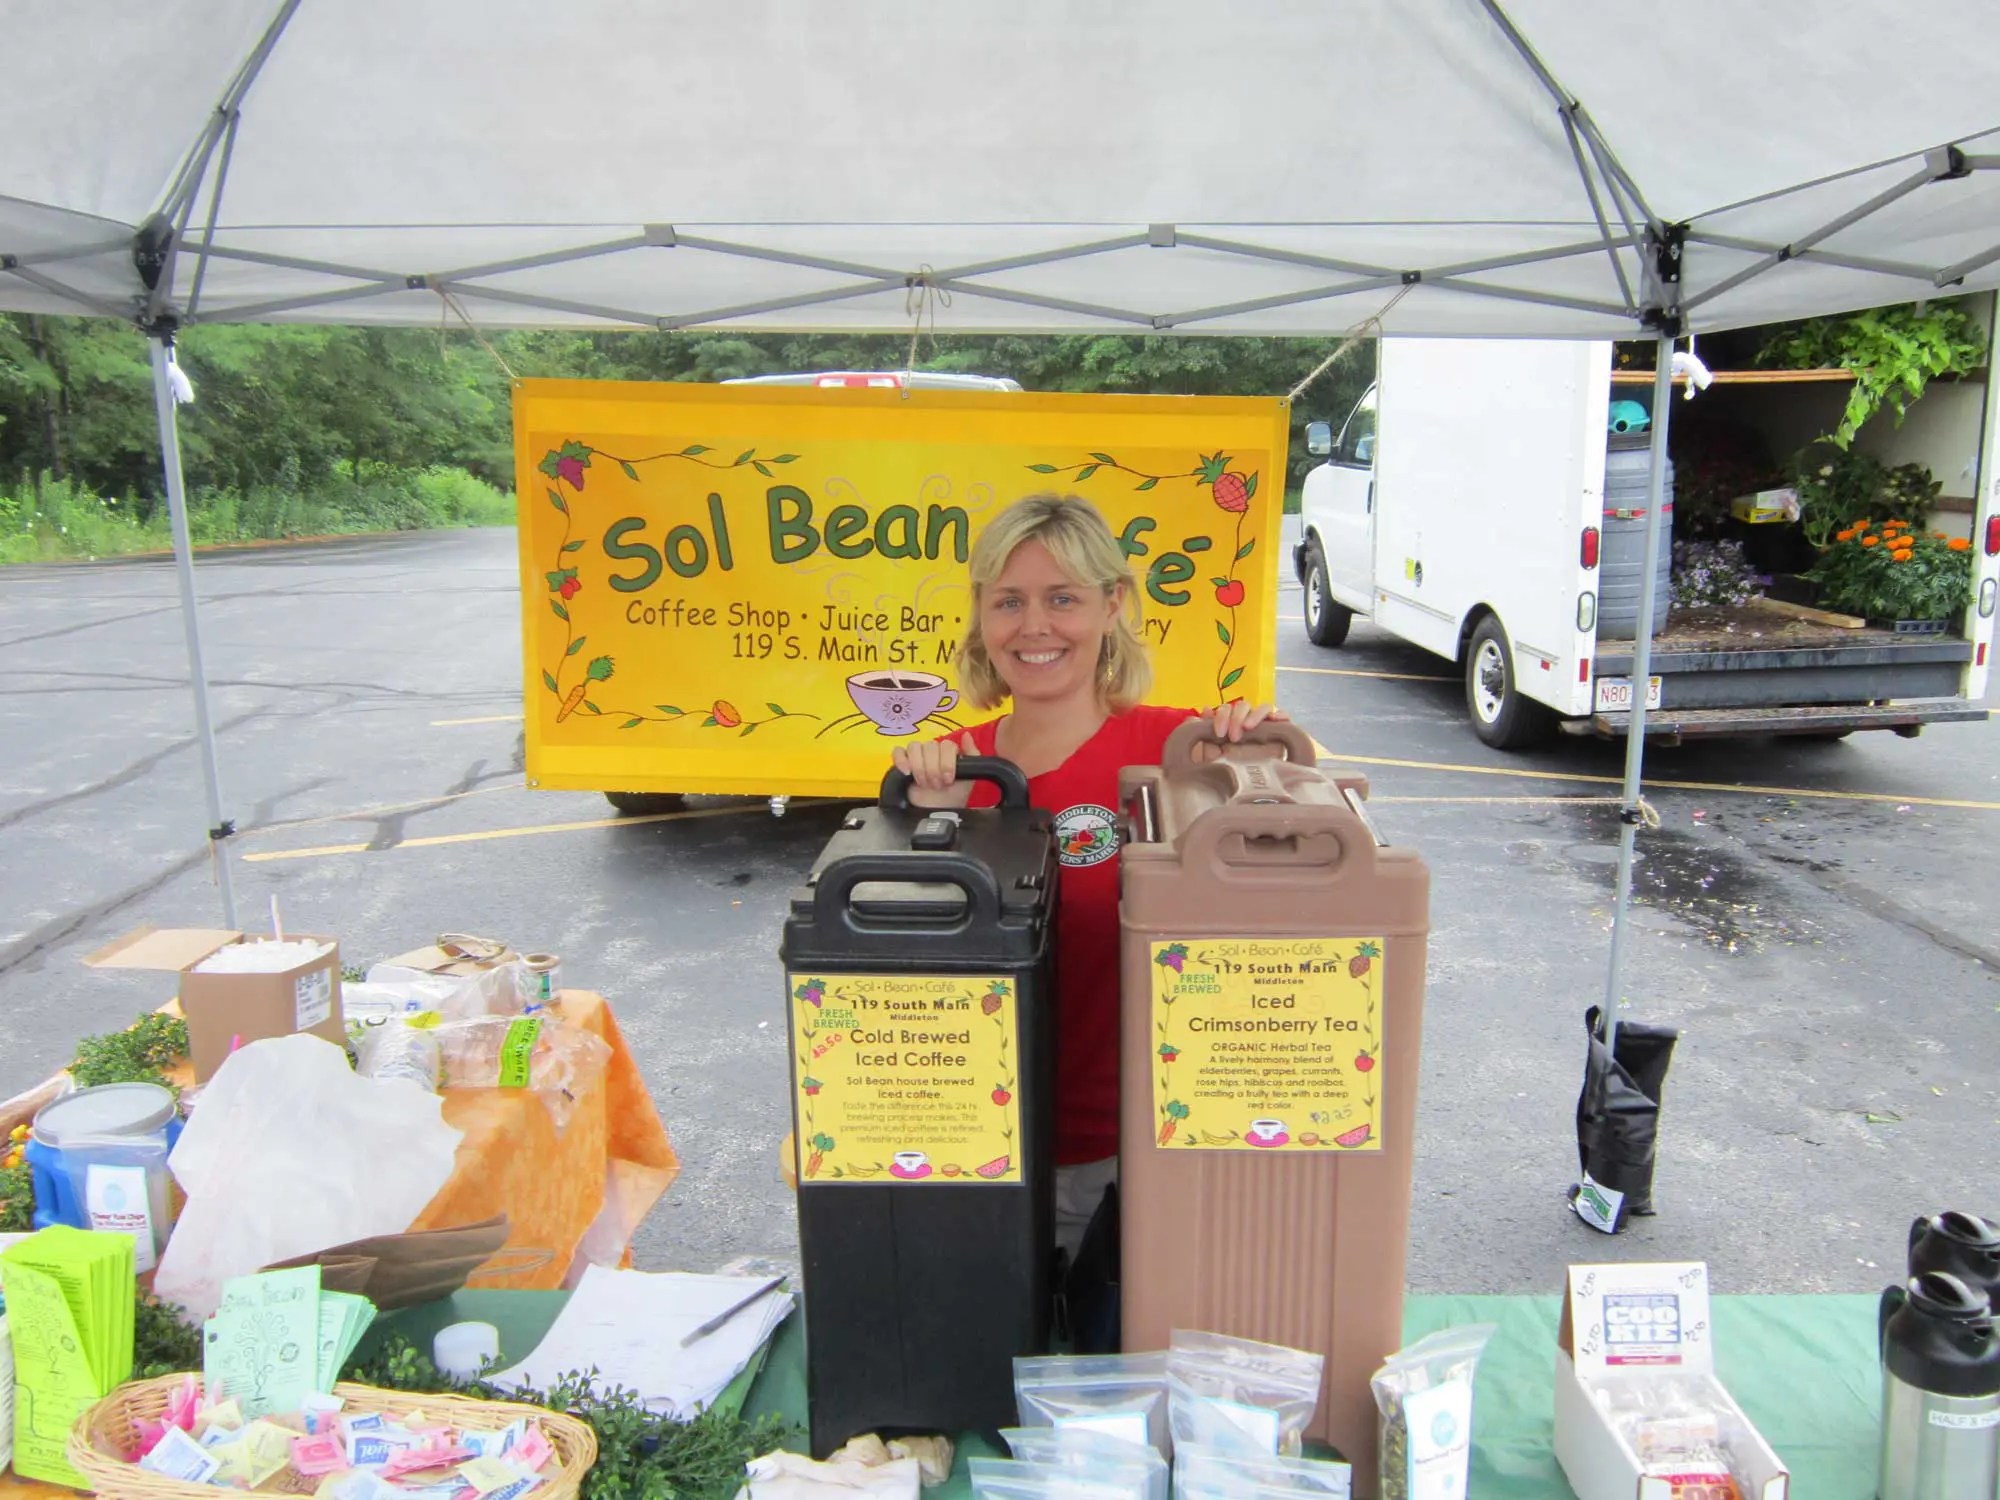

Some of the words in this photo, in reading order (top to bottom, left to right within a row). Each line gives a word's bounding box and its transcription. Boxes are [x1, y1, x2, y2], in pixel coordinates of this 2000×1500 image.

[603, 492, 733, 593] Sol
[766, 484, 969, 564] Bean
[1112, 516, 1212, 606] fé
[625, 598, 717, 627] Coffee
[727, 601, 790, 635] Shop
[819, 605, 889, 632] Juice
[900, 606, 944, 633] Bar
[732, 633, 773, 658] 119
[784, 636, 808, 660] S.
[818, 637, 878, 662] Main
[888, 640, 925, 664] St.
[1601, 685, 1659, 703] N803
[1248, 944, 1285, 956] Bean
[1214, 964, 1242, 974] 119
[1248, 963, 1293, 974] South
[1300, 962, 1337, 973] Main
[1180, 974, 1215, 983] FRESH
[883, 980, 918, 993] Bean
[1173, 984, 1222, 994] BREWED
[851, 1000, 878, 1010] 119
[884, 999, 927, 1010] South
[933, 999, 970, 1010] Main
[1251, 994, 1295, 1009] Iced
[819, 1009, 853, 1018] FRESH
[813, 1019, 860, 1029] BREWED
[1188, 1017, 1318, 1035] Crimsonberry
[1324, 1017, 1358, 1032] Tea
[850, 1029, 894, 1044] Cold
[901, 1029, 970, 1044] Brewed
[1211, 1043, 1268, 1052] ORGANIC
[1270, 1042, 1309, 1052] Herbal
[1311, 1042, 1332, 1052] Tea
[856, 1052, 898, 1066] Iced
[904, 1052, 967, 1067] Coffee
[846, 1077, 863, 1086] Sol
[865, 1077, 893, 1086] Bean
[896, 1077, 929, 1086] house
[932, 1077, 974, 1087] brewed
[878, 1090, 903, 1099] iced
